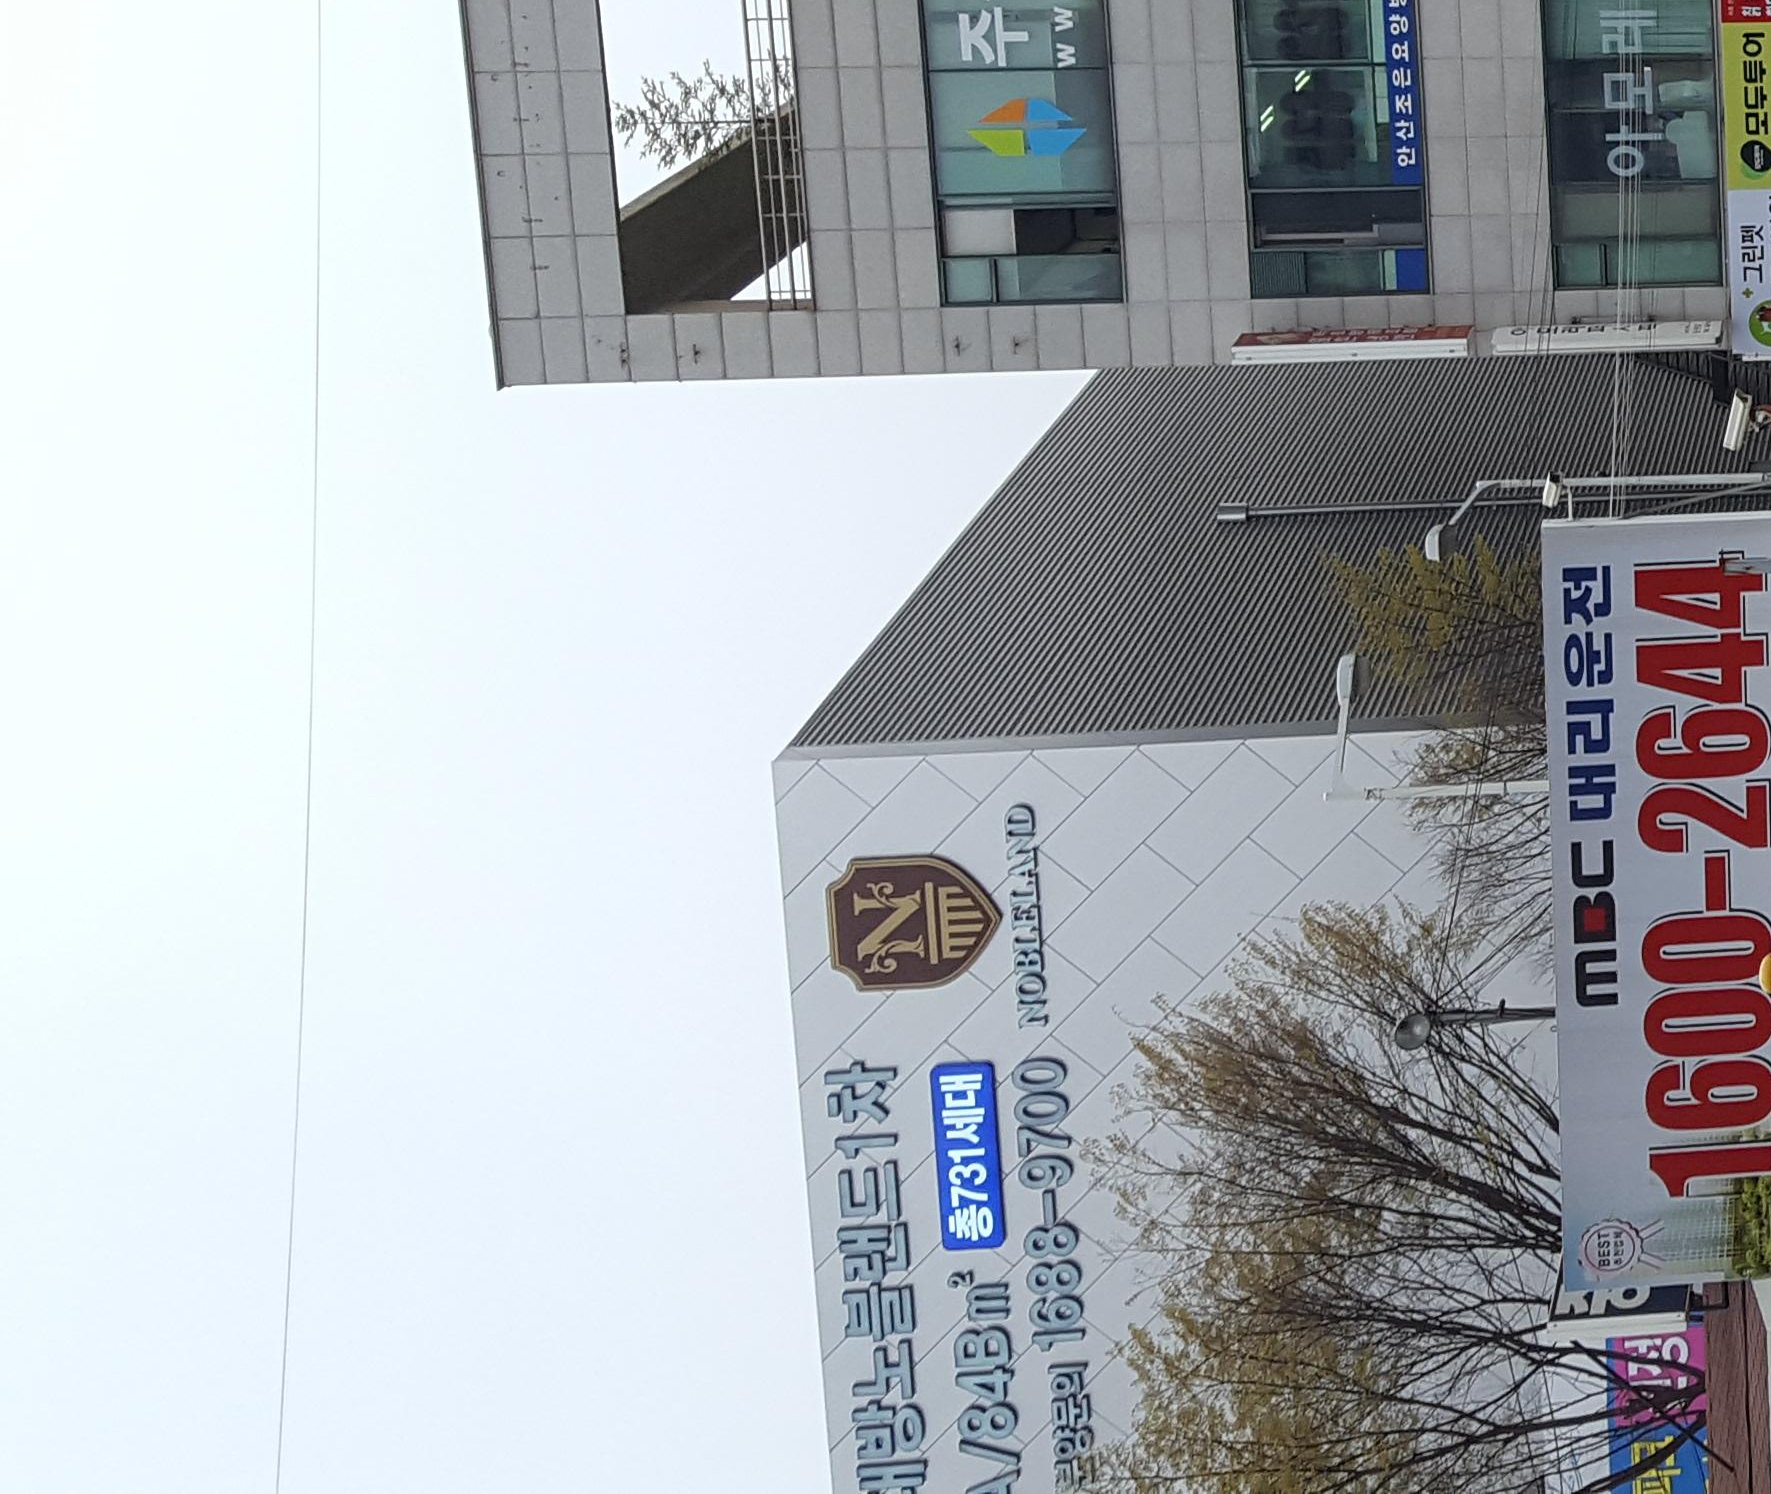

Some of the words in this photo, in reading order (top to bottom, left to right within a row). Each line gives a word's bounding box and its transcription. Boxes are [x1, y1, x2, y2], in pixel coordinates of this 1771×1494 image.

[1741, 32, 1769, 136] 모두투어
[1740, 225, 1764, 284] 그린펫
[1561, 563, 1617, 822] 대리운전
[1003, 804, 1048, 1028] NOBLELAND
[938, 1073, 995, 1241] 총731세대
[1011, 1057, 1085, 1352] 1688-9700
[1597, 1232, 1610, 1267] BEST
